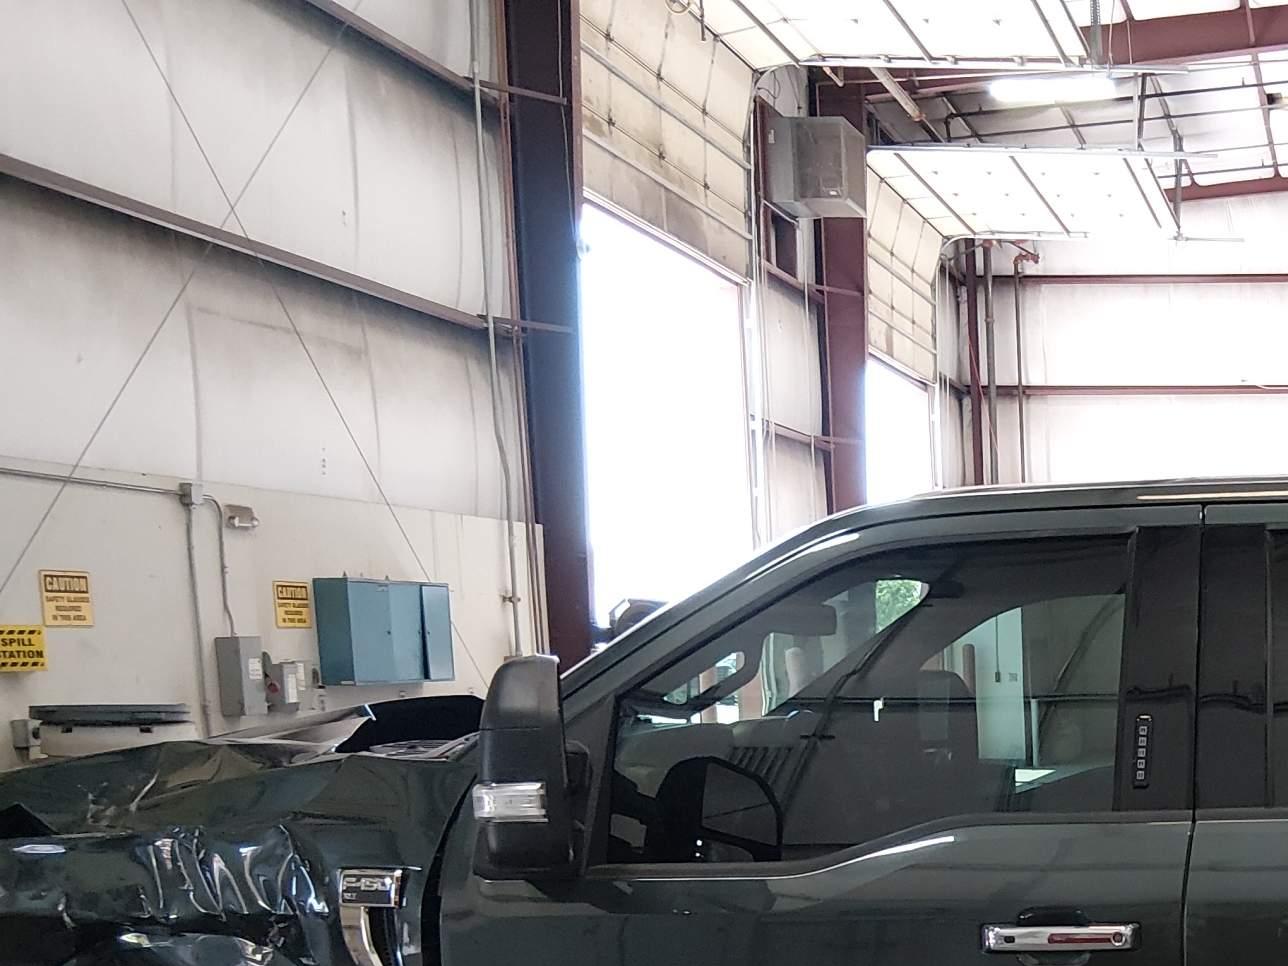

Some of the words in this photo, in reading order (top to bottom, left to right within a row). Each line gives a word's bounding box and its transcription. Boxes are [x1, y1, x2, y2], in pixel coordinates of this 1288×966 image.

[46, 577, 87, 591] CAUTION
[1, 638, 36, 647] SPILL
[0, 650, 44, 659] TATION
[343, 877, 392, 891] F-150
